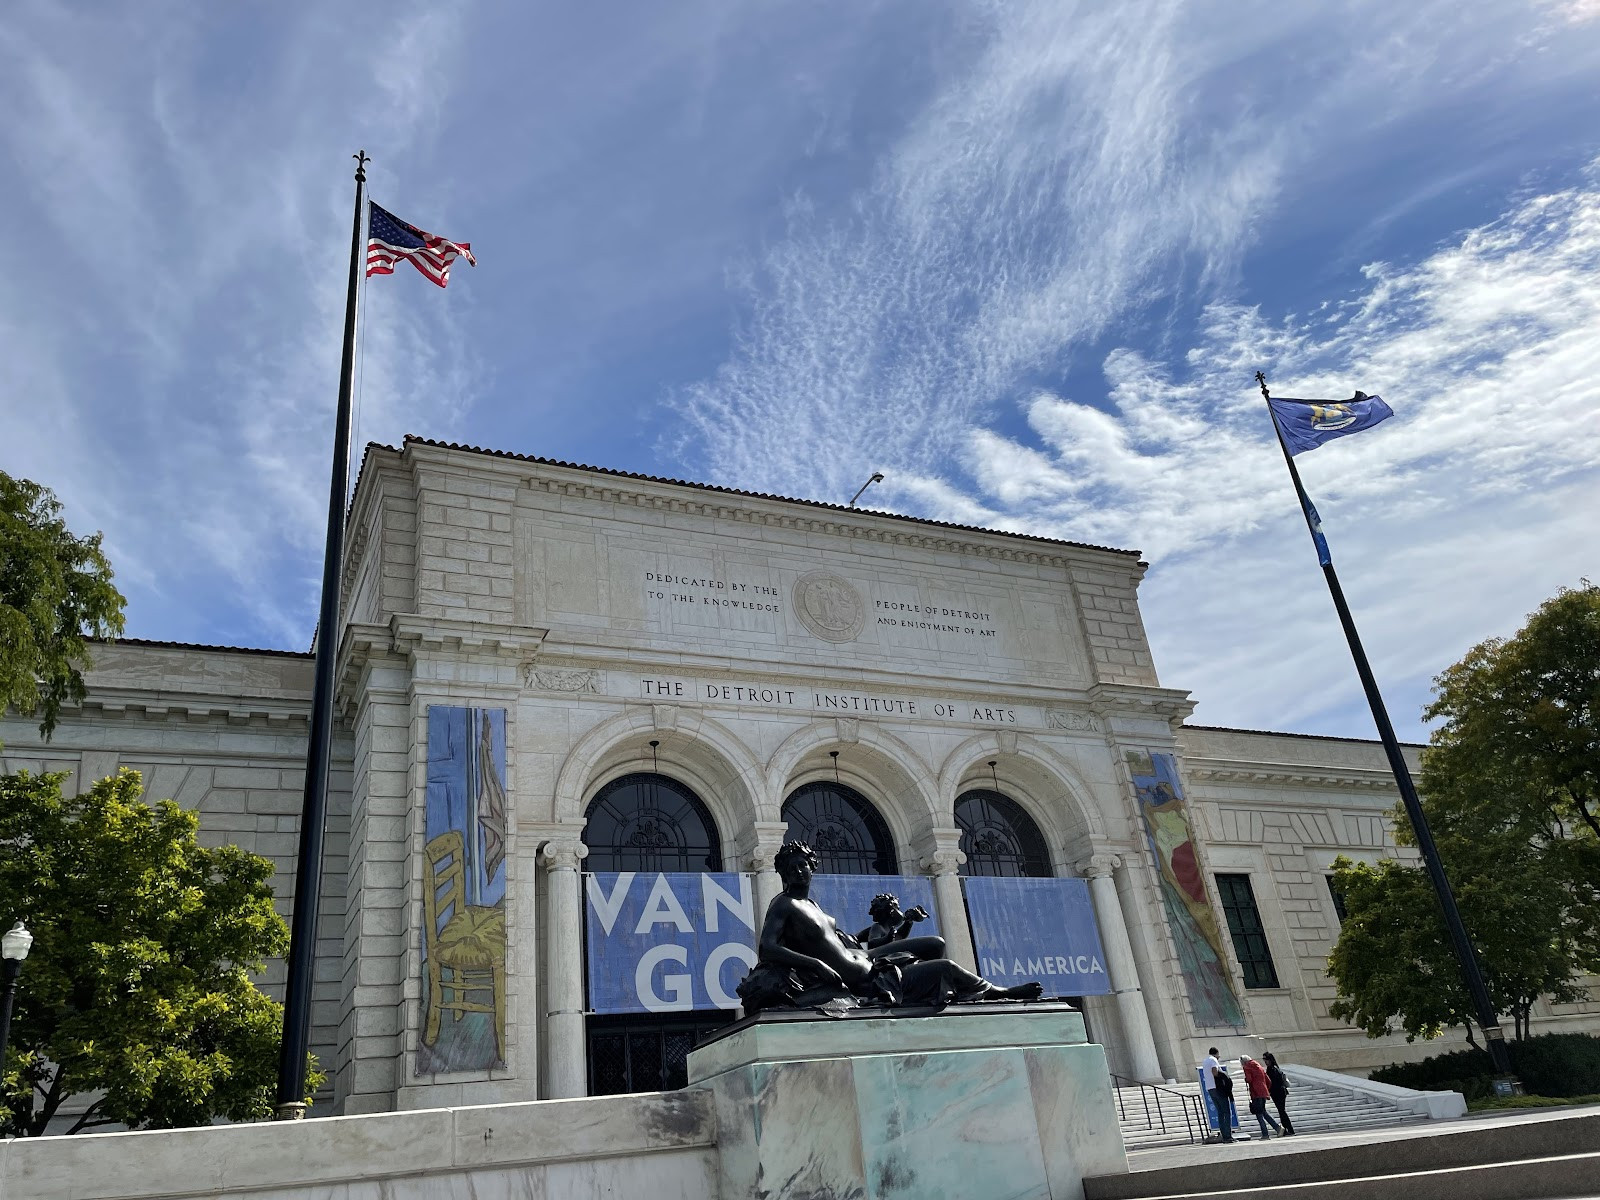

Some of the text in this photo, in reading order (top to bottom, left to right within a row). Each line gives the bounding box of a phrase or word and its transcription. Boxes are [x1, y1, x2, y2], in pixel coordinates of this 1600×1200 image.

[646, 572, 990, 621] DEDICATED BY THE PEOPLE OF DETROIT
[648, 591, 664, 600] TO
[672, 593, 695, 603] THE
[703, 597, 780, 613] KNOWLEDGE
[877, 617, 897, 626] AND
[964, 627, 975, 635] OF
[979, 629, 996, 637] ART
[642, 679, 1016, 723] THE DETROIT INSTITUTE OF ARTS
[586, 871, 756, 938] VAN
[982, 955, 1104, 977] IN AMERICA
